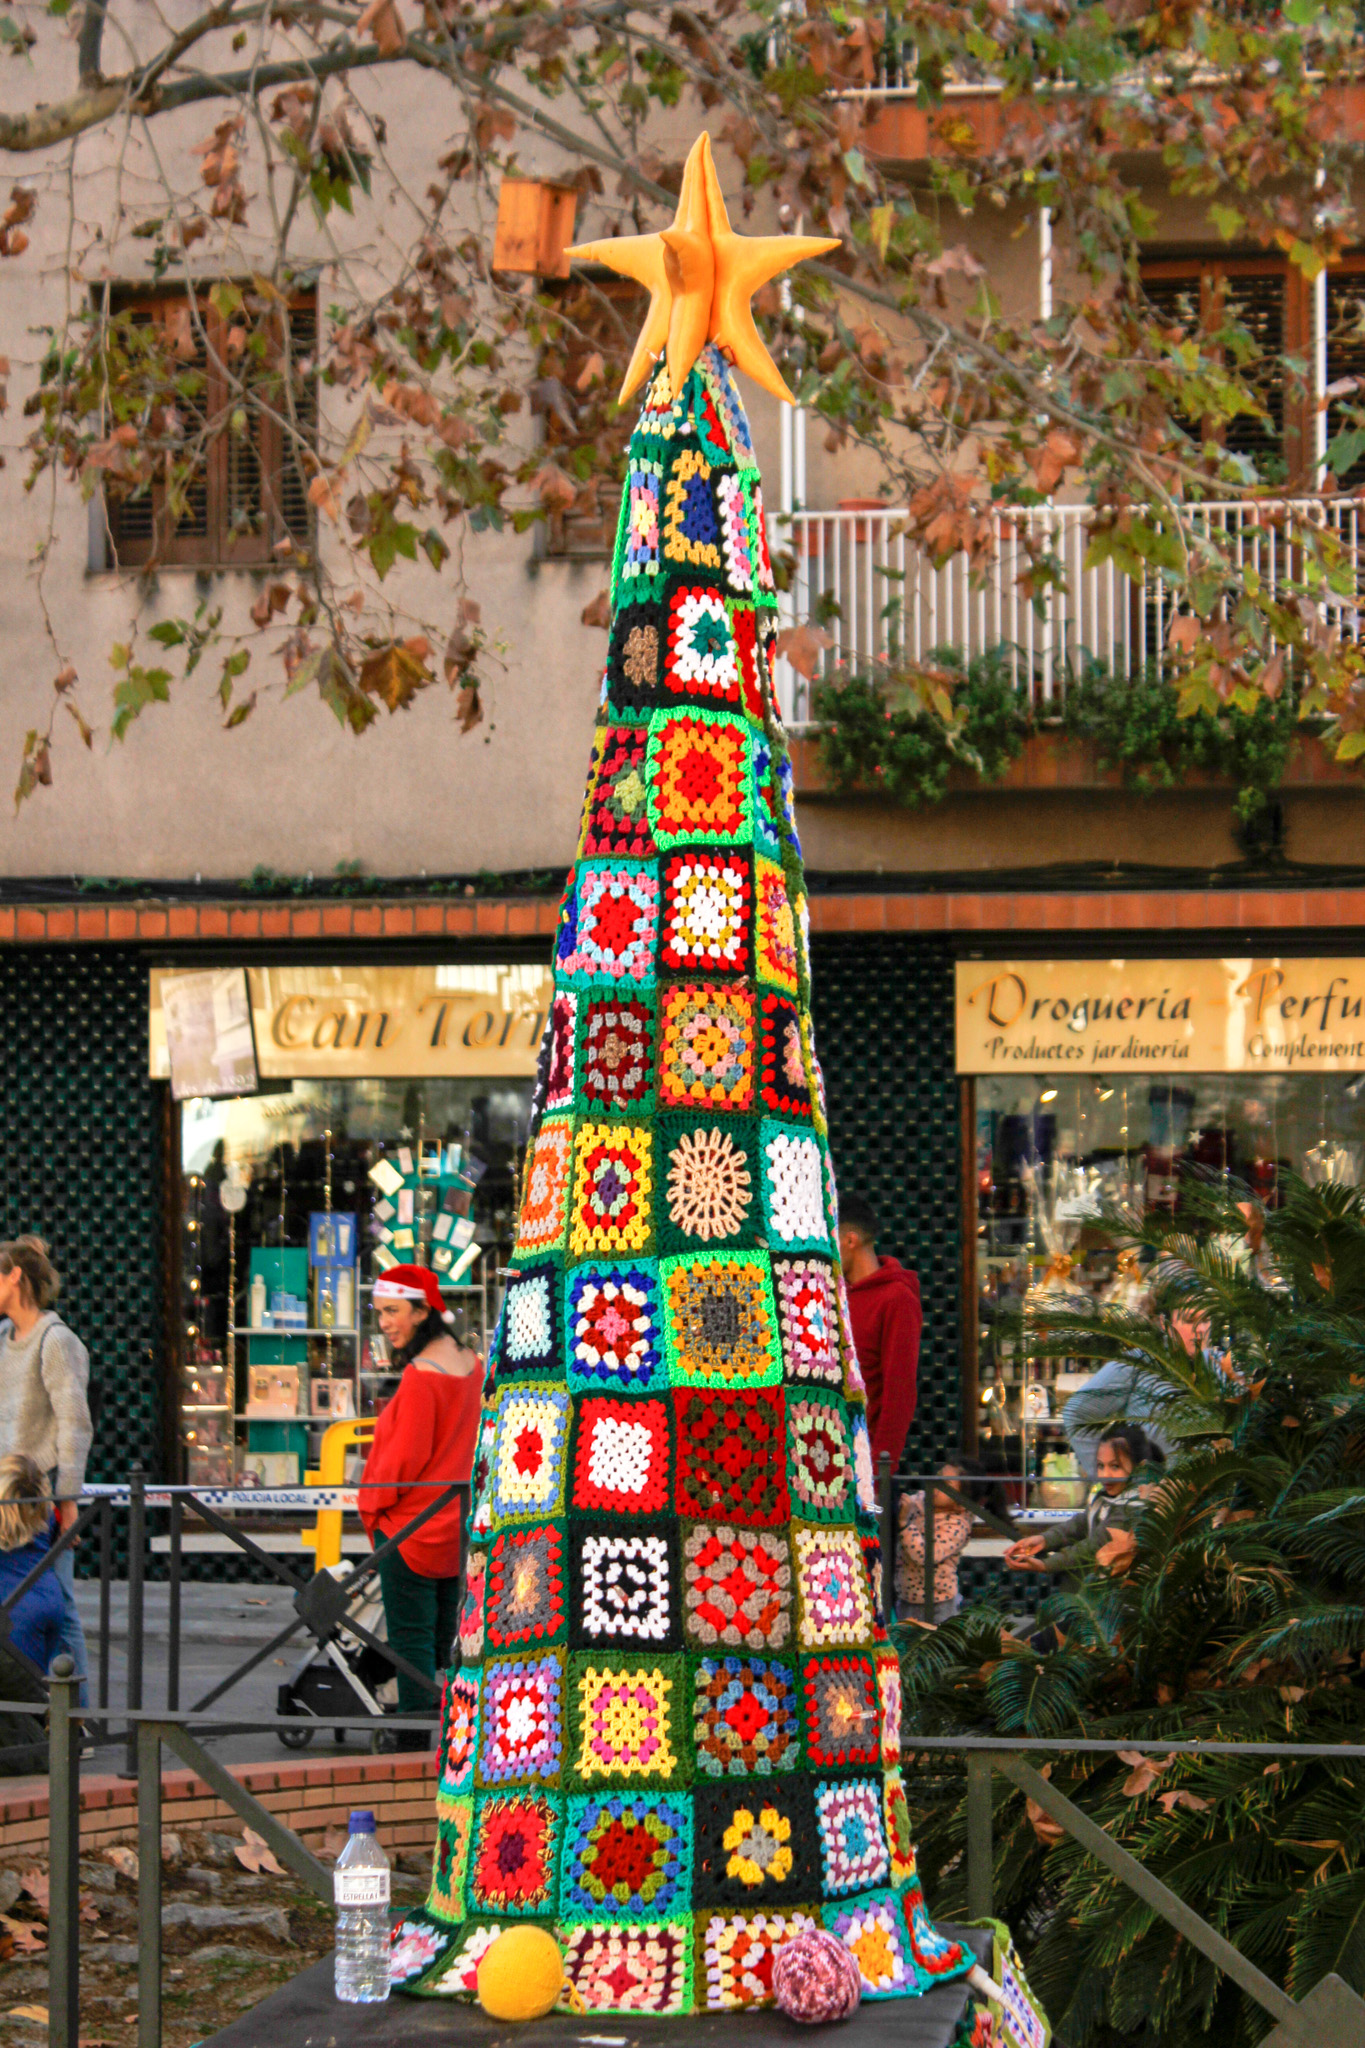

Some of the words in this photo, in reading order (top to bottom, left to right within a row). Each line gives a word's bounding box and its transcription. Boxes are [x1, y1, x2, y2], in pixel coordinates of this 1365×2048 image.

[271, 995, 400, 1050] Can
[967, 973, 1192, 1033] Drogueria
[1235, 967, 1364, 1031] Perfu
[984, 1035, 1085, 1060] Productes
[1091, 1034, 1190, 1064] jardineria
